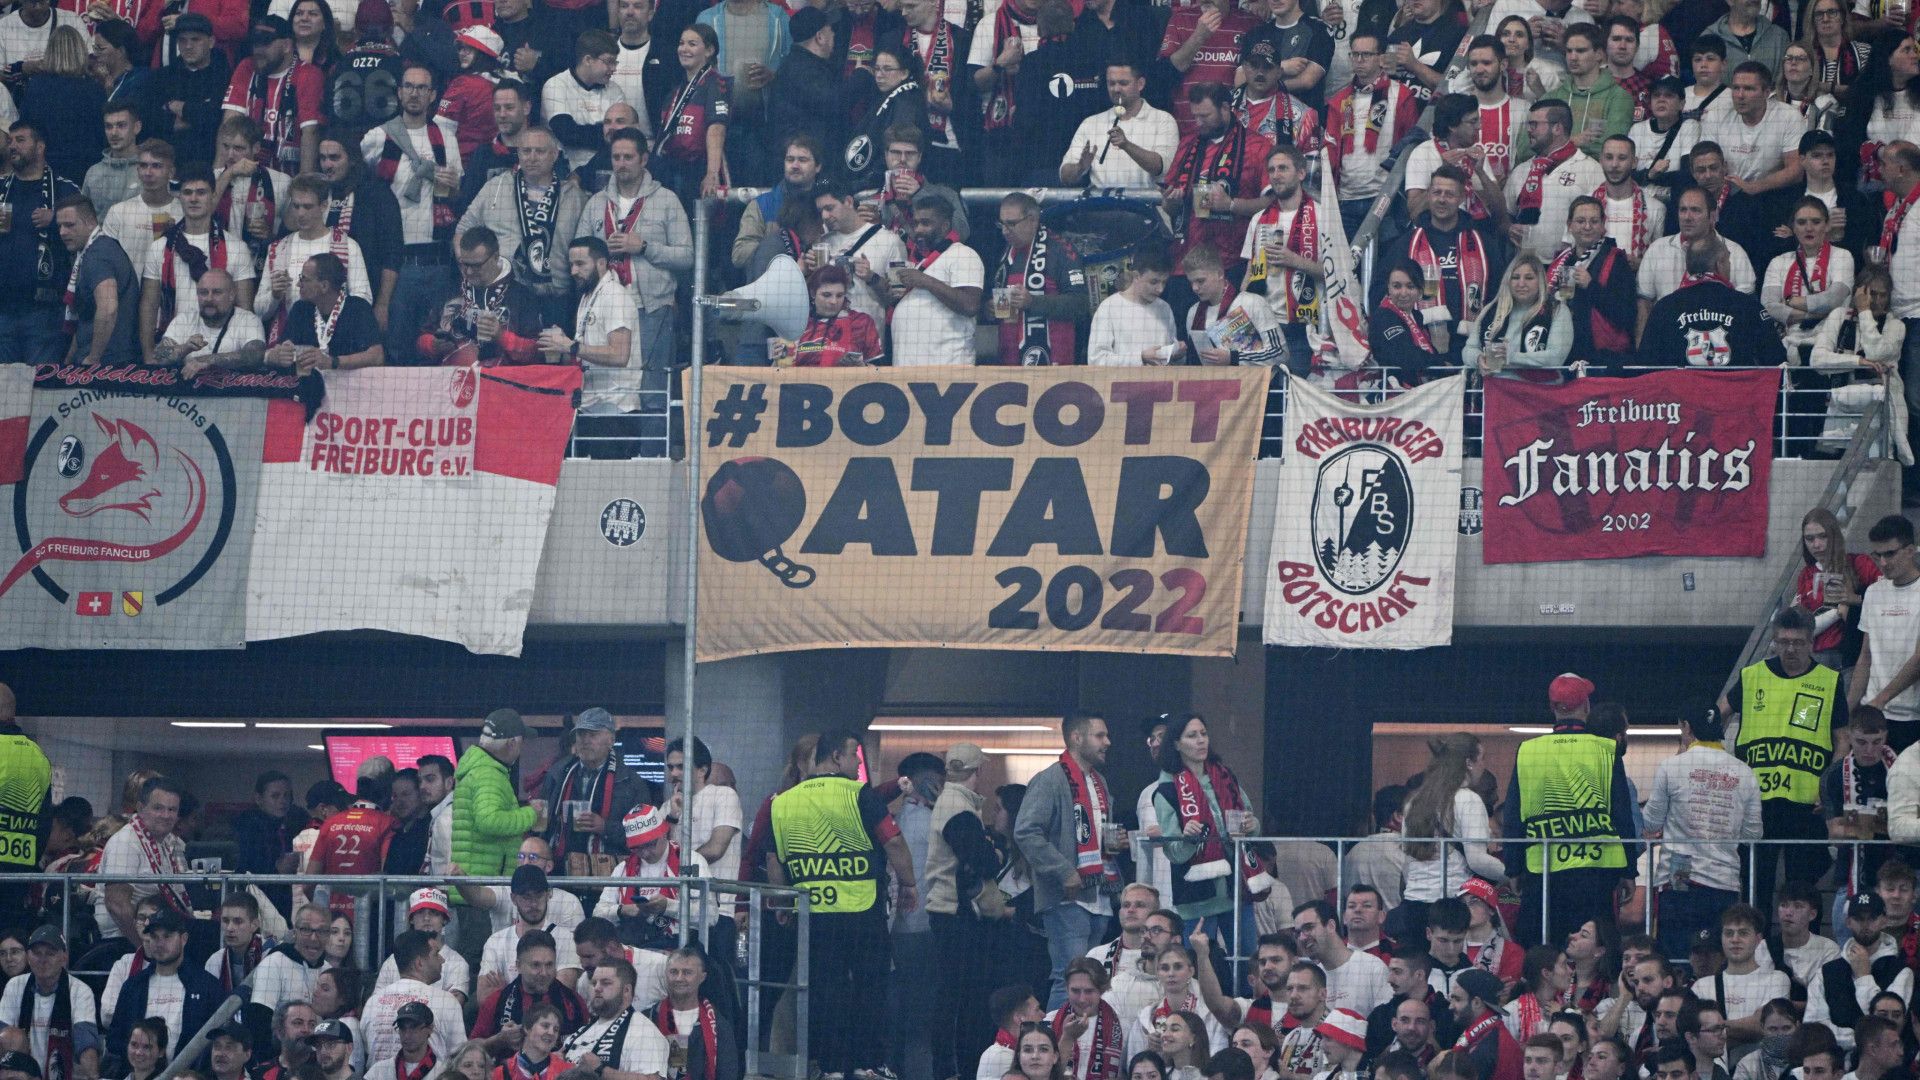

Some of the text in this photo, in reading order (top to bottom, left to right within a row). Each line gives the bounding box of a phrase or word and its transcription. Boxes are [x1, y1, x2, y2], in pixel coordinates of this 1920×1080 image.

[353, 57, 381, 68] OZZY
[1678, 309, 1734, 329] Freiburg
[706, 379, 1241, 448] #BOYCOTT
[1576, 399, 1681, 427] Freiburg
[314, 411, 473, 447] SPORT-CLUB
[1295, 416, 1444, 465] FREIBURGER
[311, 443, 470, 476] FREIBURG e.V.
[1601, 512, 1651, 532] 2002
[48, 544, 99, 556] FREIBURG
[100, 547, 150, 559] FANCLUB
[988, 565, 1208, 635] 2022
[1278, 560, 1431, 634] BOTSCHAFT
[1759, 771, 1792, 793] 394
[1526, 812, 1615, 840] STEWAR
[335, 834, 361, 855] 22
[1556, 842, 1603, 863] 043
[809, 886, 838, 906] 59
